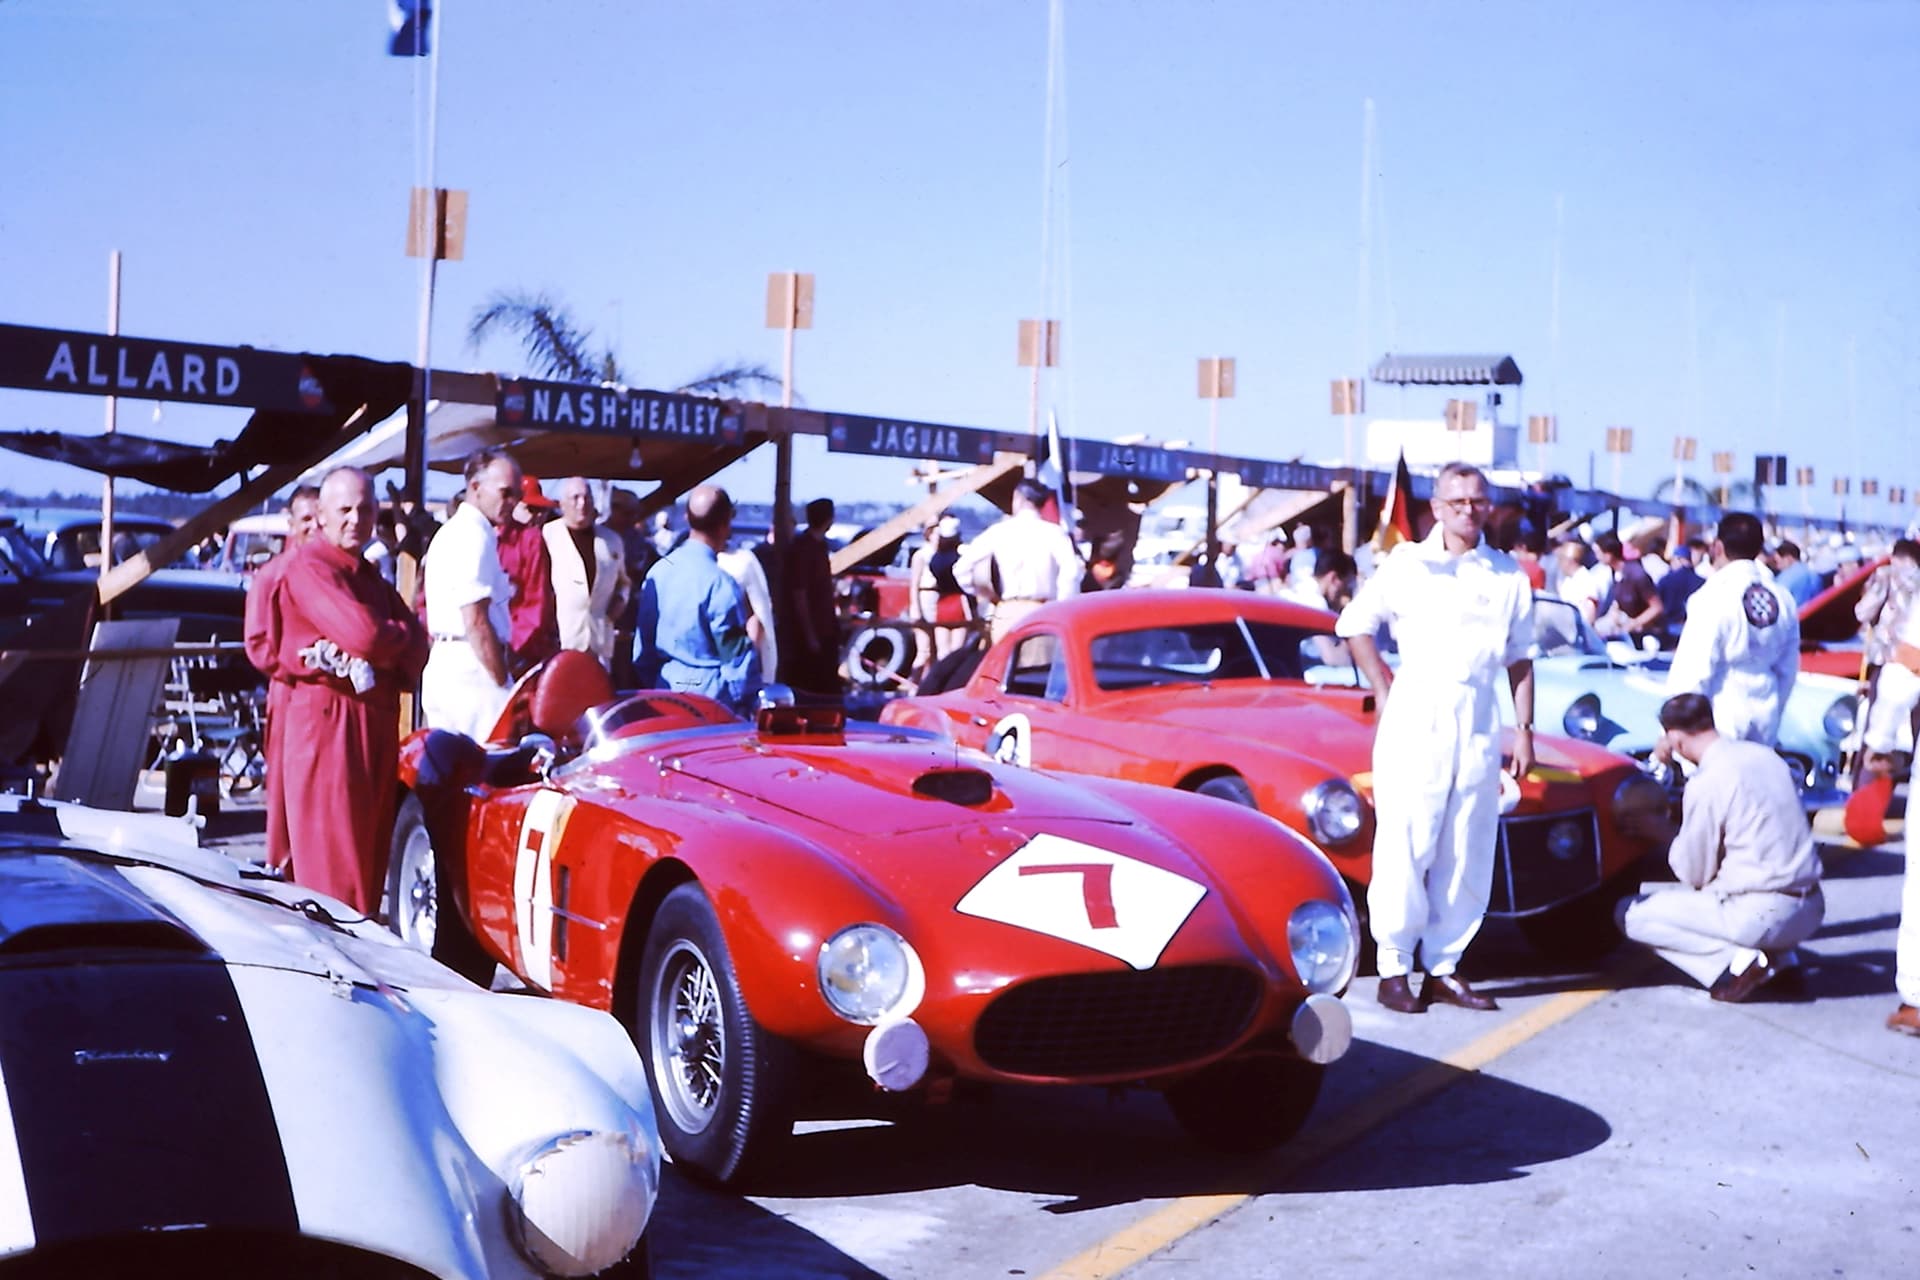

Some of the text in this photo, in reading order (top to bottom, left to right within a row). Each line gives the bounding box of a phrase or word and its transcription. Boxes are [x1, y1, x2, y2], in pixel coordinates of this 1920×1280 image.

[45, 341, 240, 396] ALLARD
[871, 423, 959, 457] JAGUAR
[1018, 863, 1120, 929] 7
